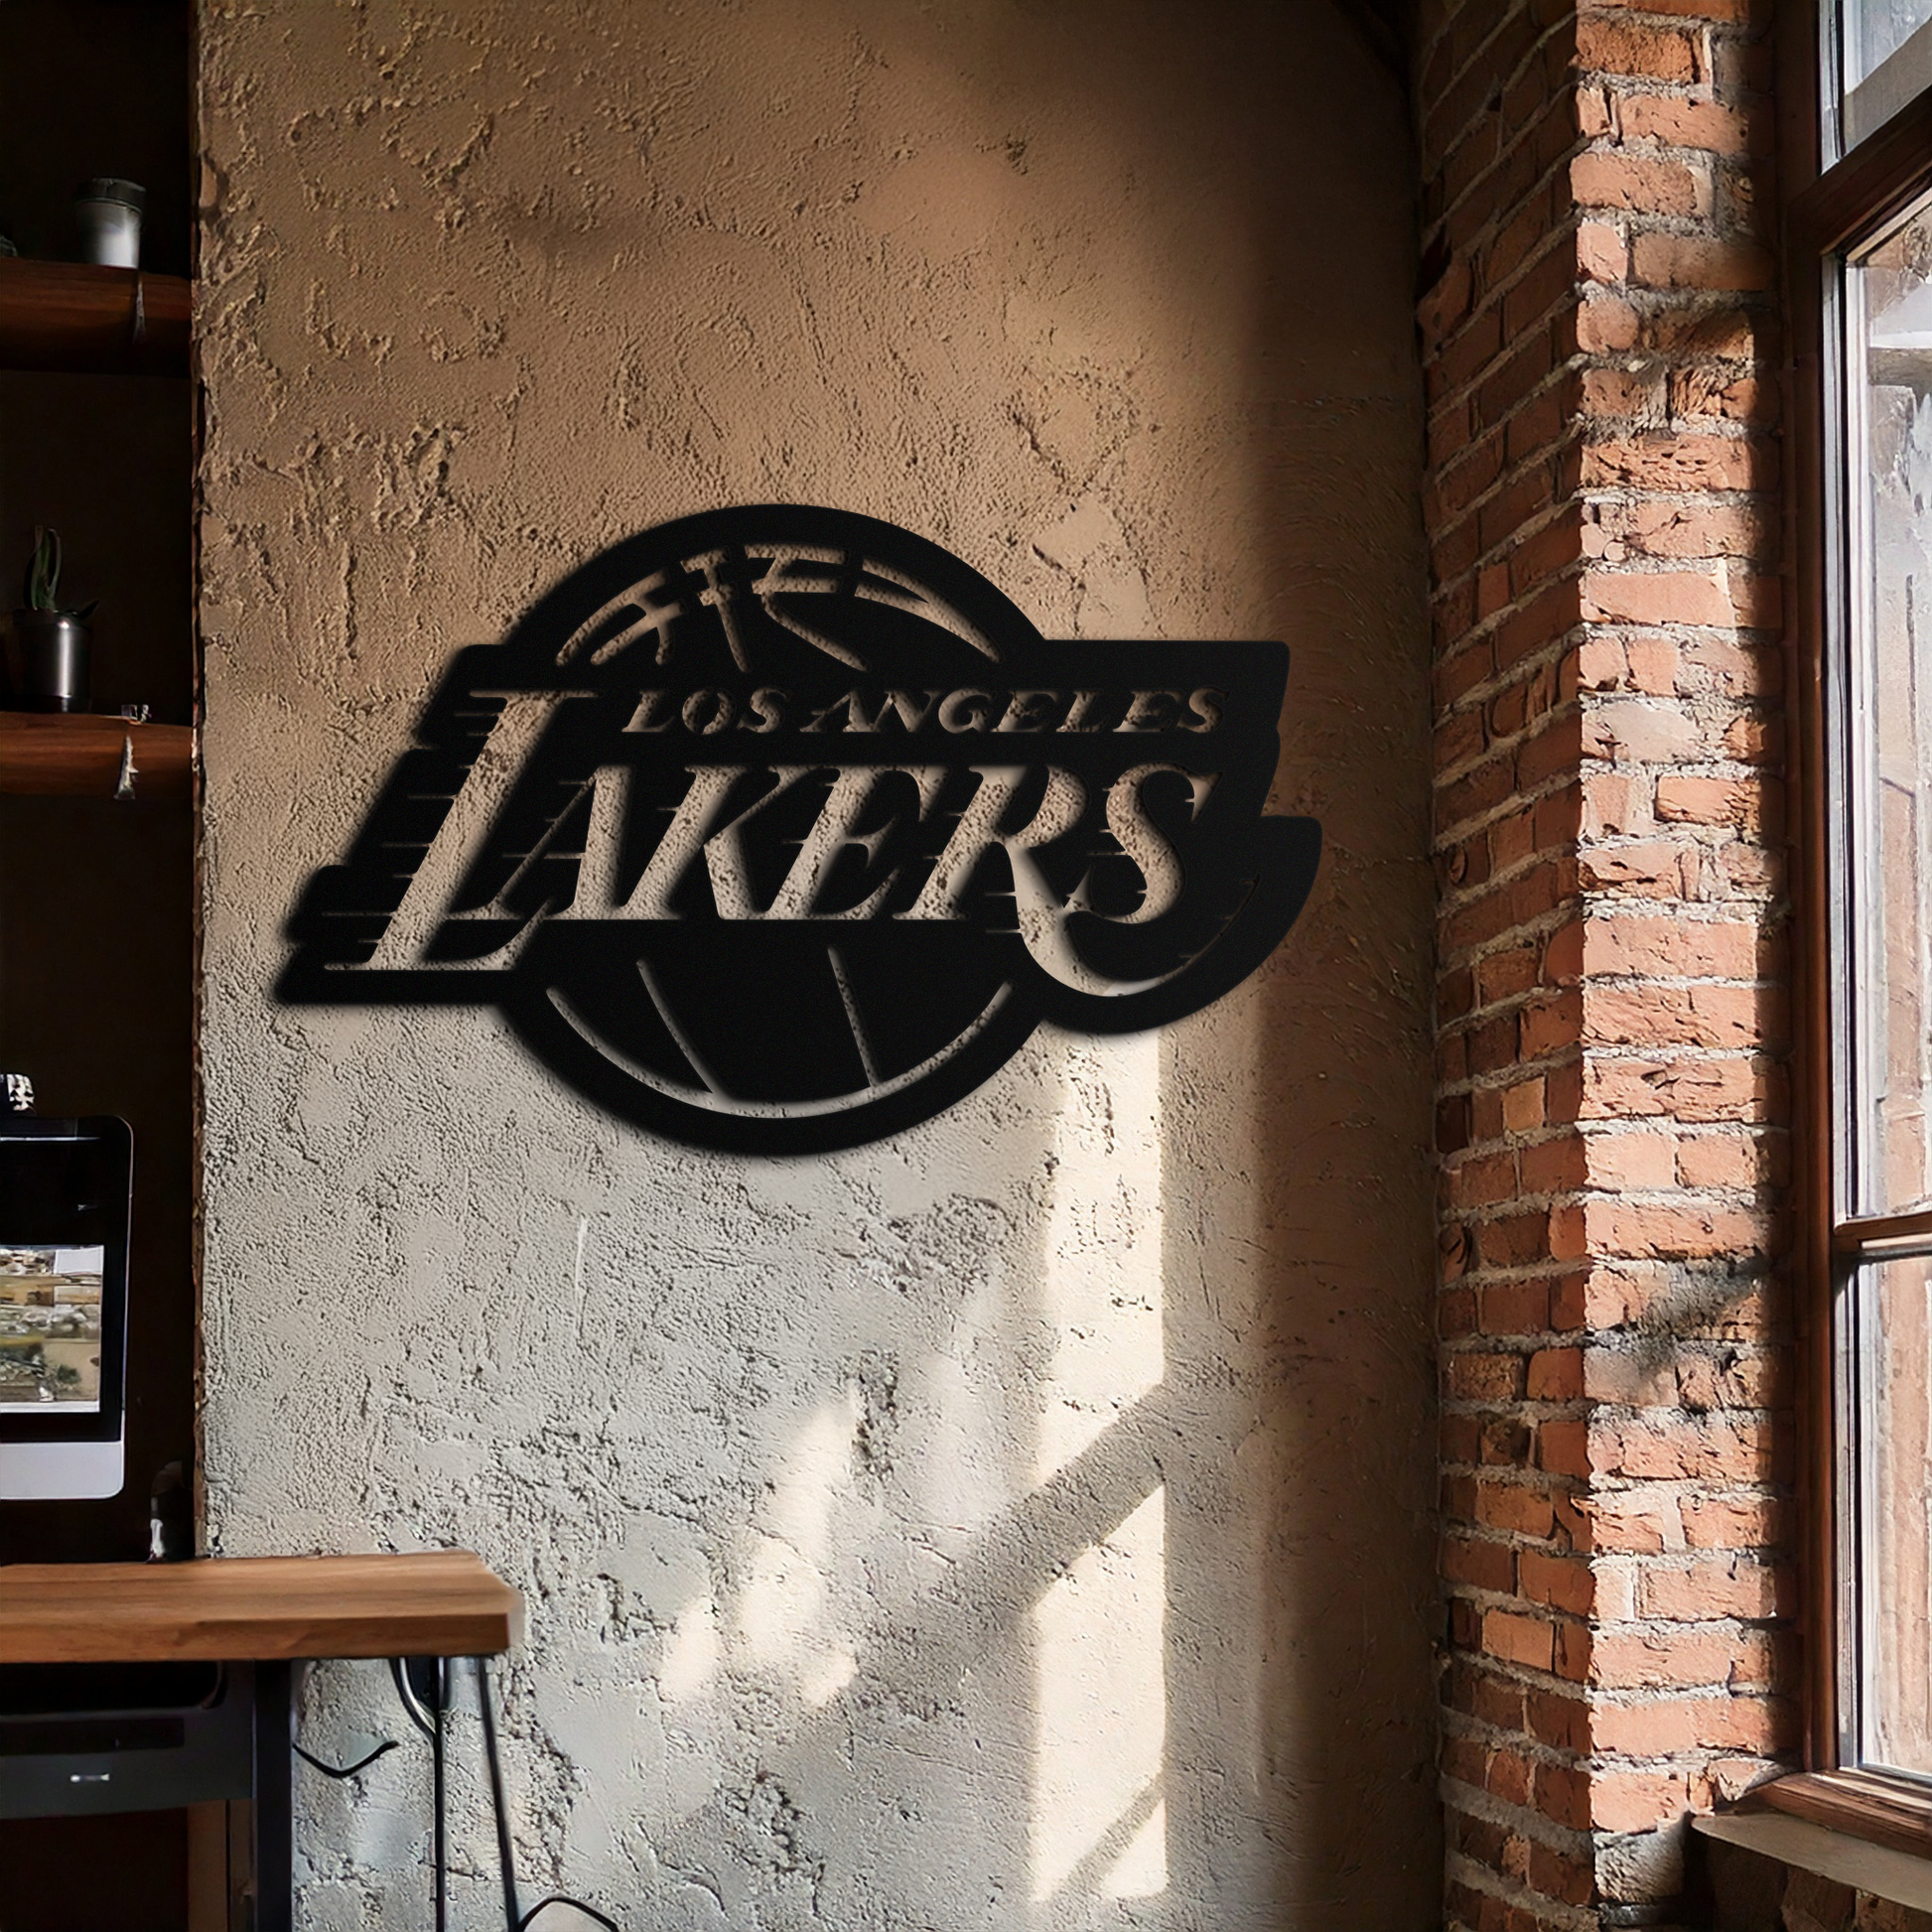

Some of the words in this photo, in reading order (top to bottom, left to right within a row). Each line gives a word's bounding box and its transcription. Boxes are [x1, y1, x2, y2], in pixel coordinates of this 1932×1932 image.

[621, 688, 790, 734] LOS
[799, 688, 1228, 734] ANGELES
[324, 689, 1253, 997] LAKERS
